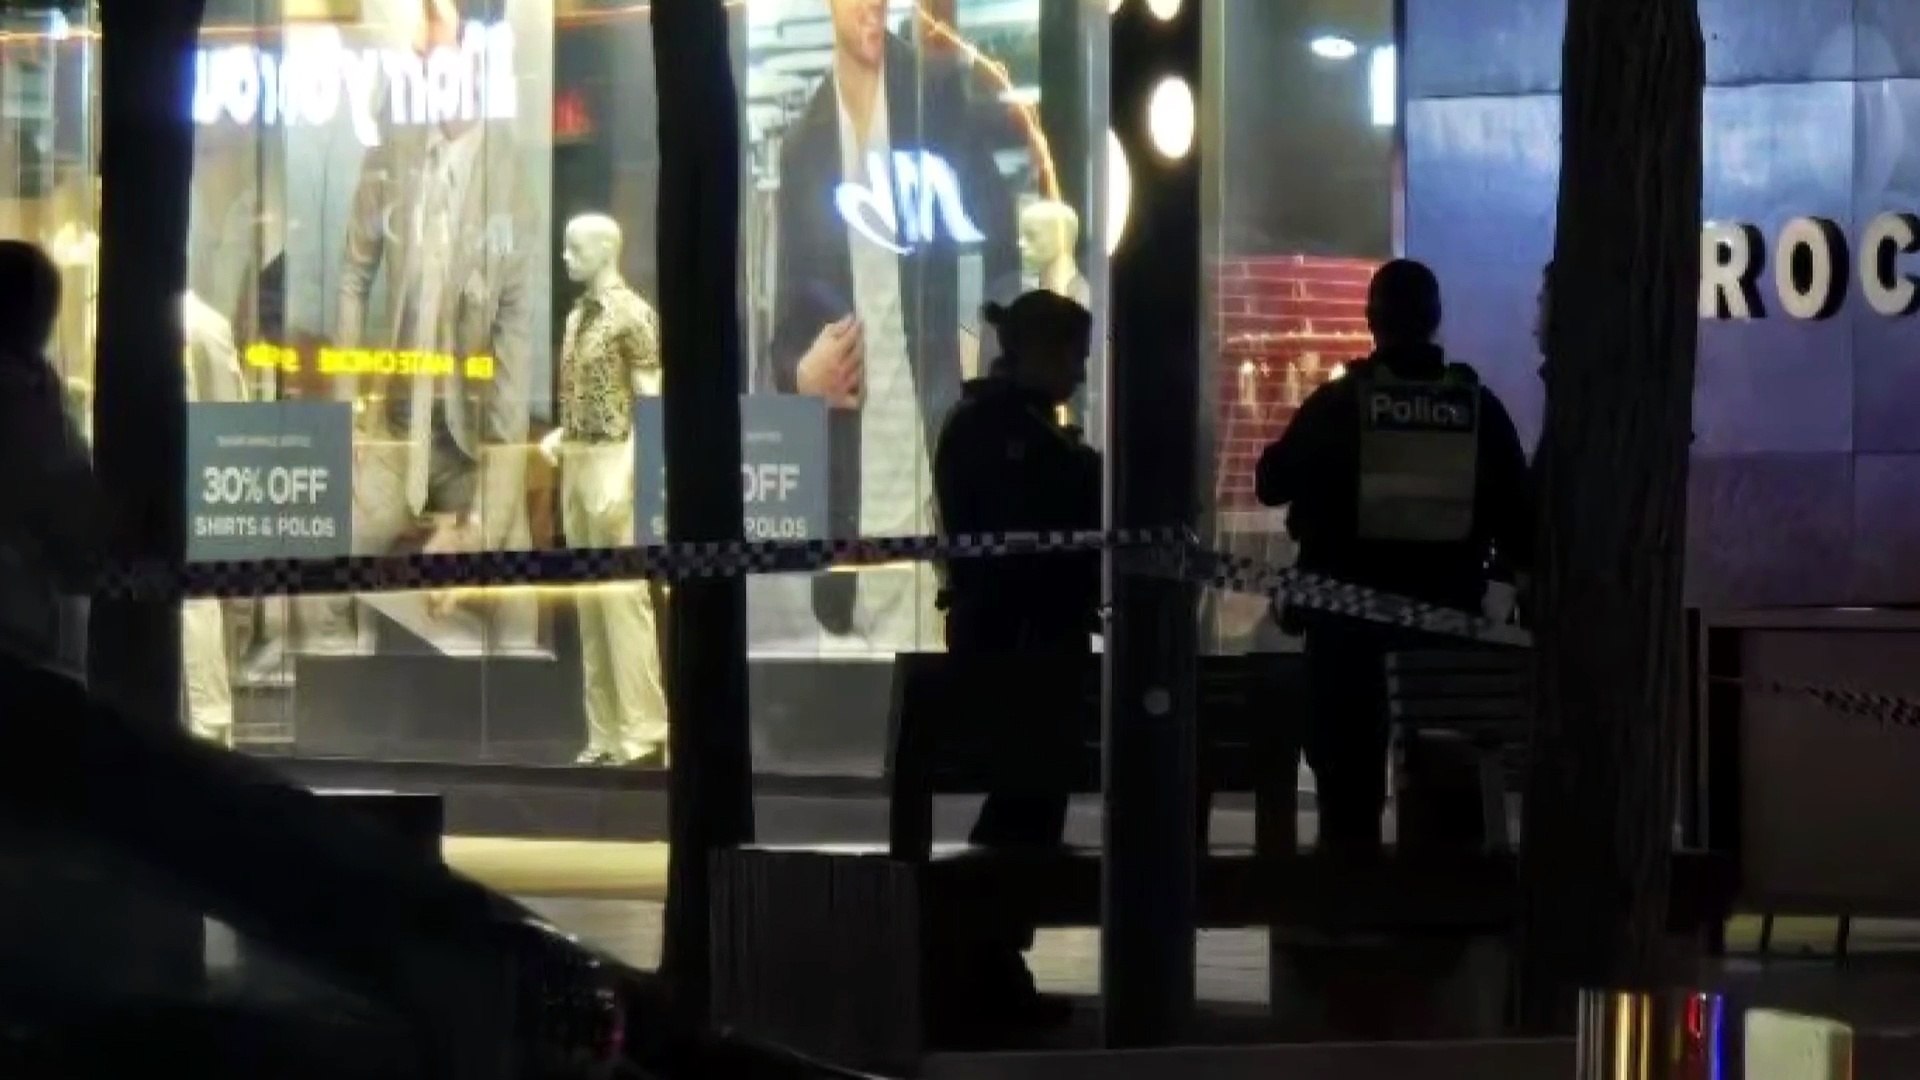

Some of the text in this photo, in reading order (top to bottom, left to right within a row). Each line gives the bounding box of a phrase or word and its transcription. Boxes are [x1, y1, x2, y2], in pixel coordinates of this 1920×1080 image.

[1699, 214, 1919, 318] ROC
[1371, 394, 1472, 426] Police
[202, 466, 329, 504] 30% OFF
[195, 516, 336, 537] SHIRTS & POLOS
